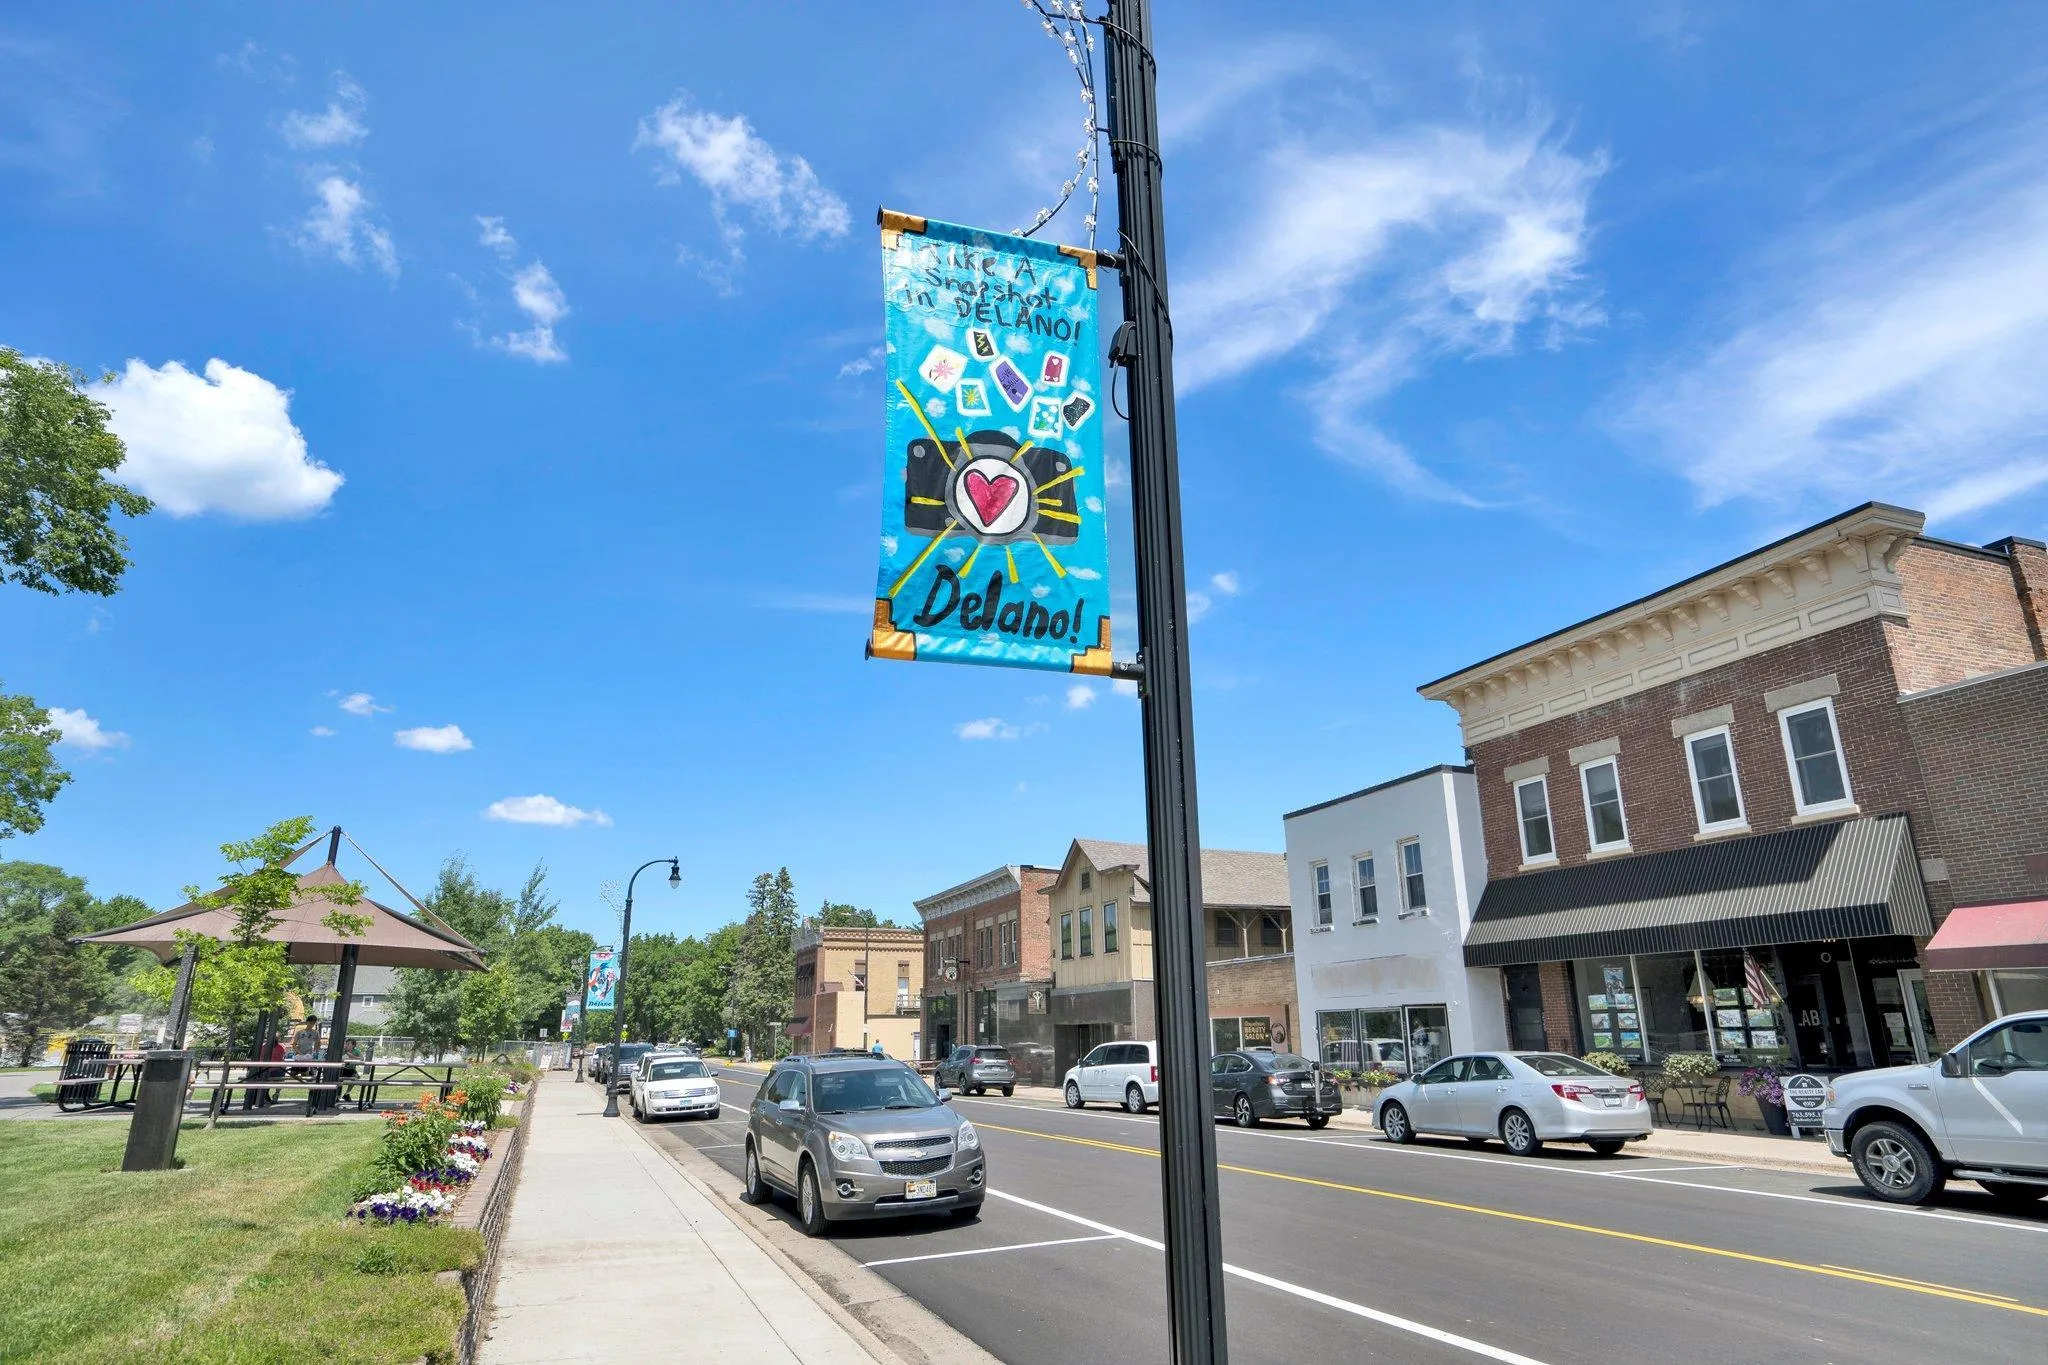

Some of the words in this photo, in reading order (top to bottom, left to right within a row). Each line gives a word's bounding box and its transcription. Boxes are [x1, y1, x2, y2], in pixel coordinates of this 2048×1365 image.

[924, 267, 1058, 310] Snapshot
[1014, 256, 1036, 286] A
[904, 283, 935, 309] in
[954, 296, 1081, 346] DELANO!
[912, 563, 1085, 645] Delano!
[1244, 1026, 1266, 1034] BEAUTY
